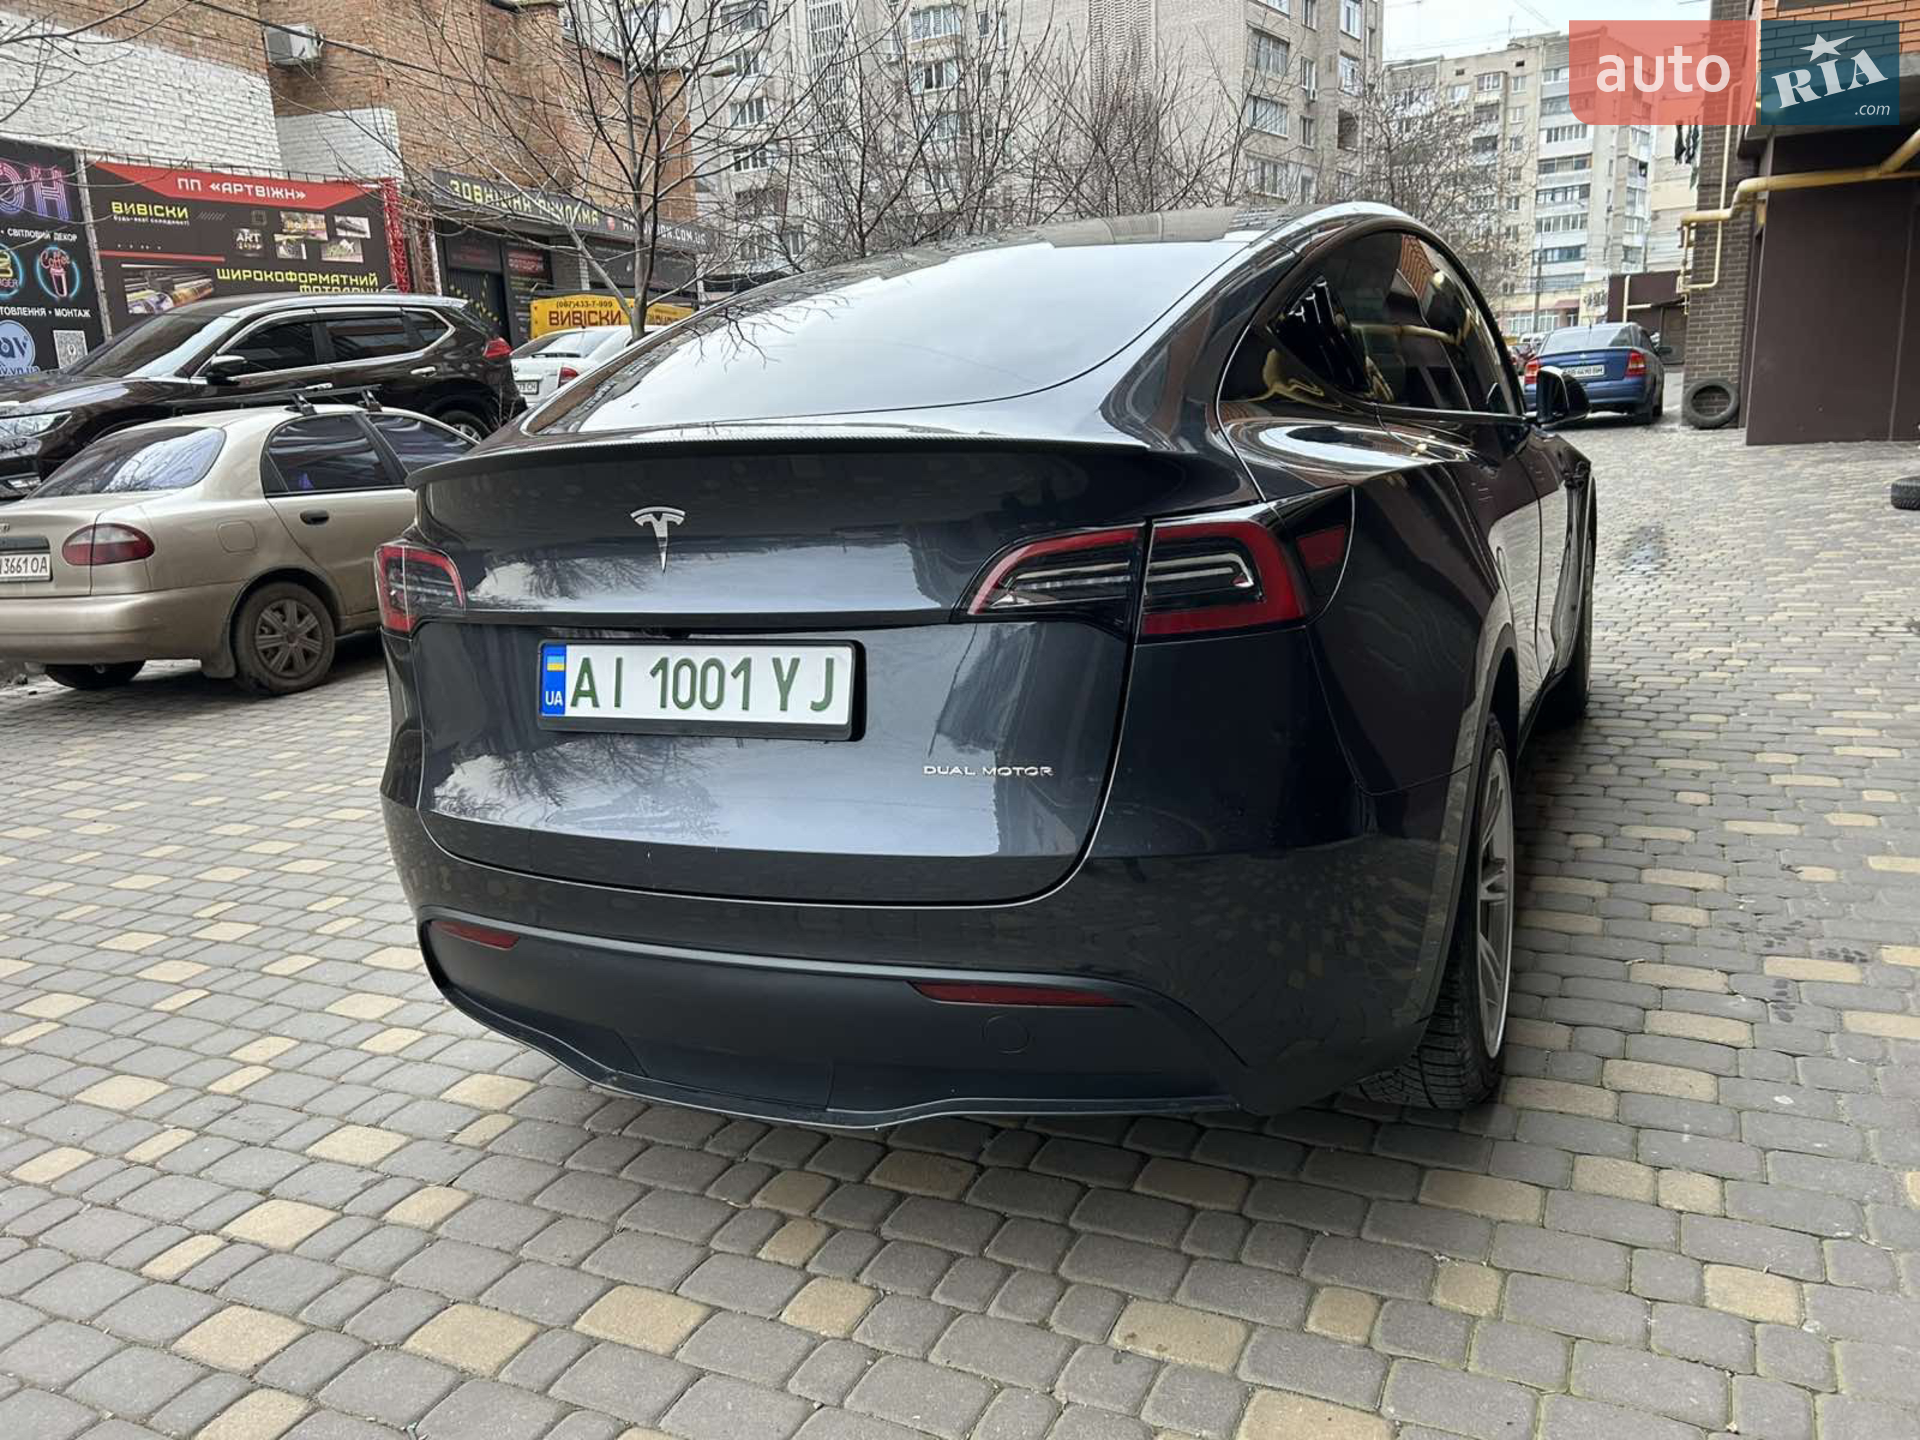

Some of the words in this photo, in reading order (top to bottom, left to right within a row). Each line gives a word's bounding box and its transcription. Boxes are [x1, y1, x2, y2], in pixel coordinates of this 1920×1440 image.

[177, 178, 202, 192] ПП
[209, 183, 307, 201] «АРТВІЖН»
[111, 201, 189, 219] ВИВІСКИ
[53, 231, 78, 242] ДЕКОР
[216, 268, 379, 287] ШИРОКОФОРМАТНИЙ
[54, 308, 91, 318] МОНТАЖ
[549, 310, 622, 327] ВИВІСКИ
[570, 657, 623, 708] AI
[649, 657, 752, 711] 1001
[771, 657, 835, 712] YJ
[545, 690, 563, 706] UA
[923, 765, 976, 776] DUAL
[982, 766, 1054, 777] MOTOR
